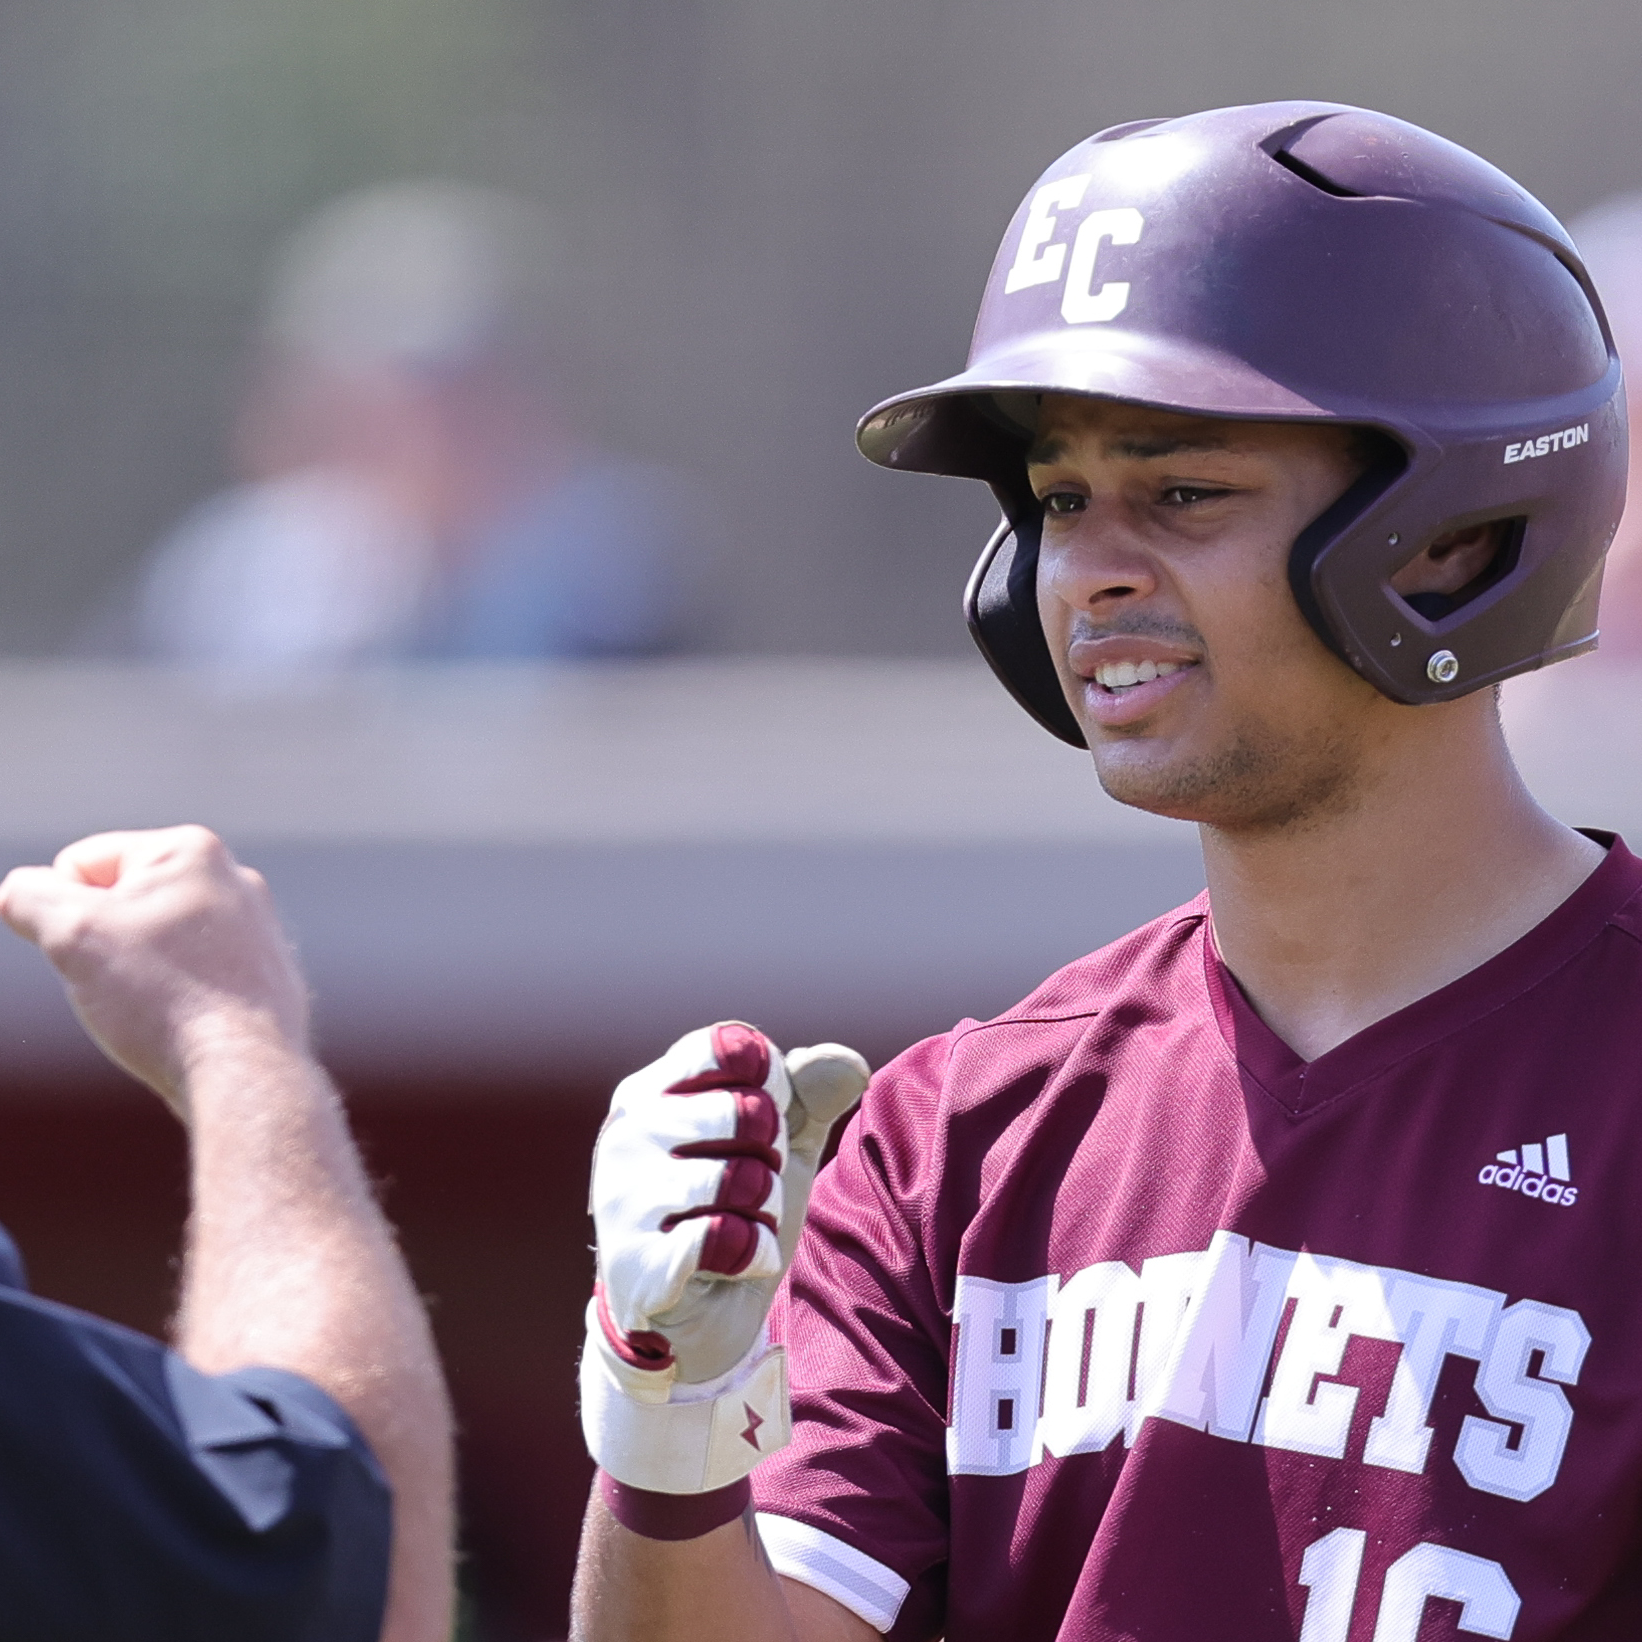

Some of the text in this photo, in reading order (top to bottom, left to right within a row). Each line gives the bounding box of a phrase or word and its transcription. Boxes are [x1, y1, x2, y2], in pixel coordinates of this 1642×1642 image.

[1004, 172, 1145, 325] EC
[1503, 423, 1589, 464] EASTON
[1478, 1165, 1579, 1206] adidas
